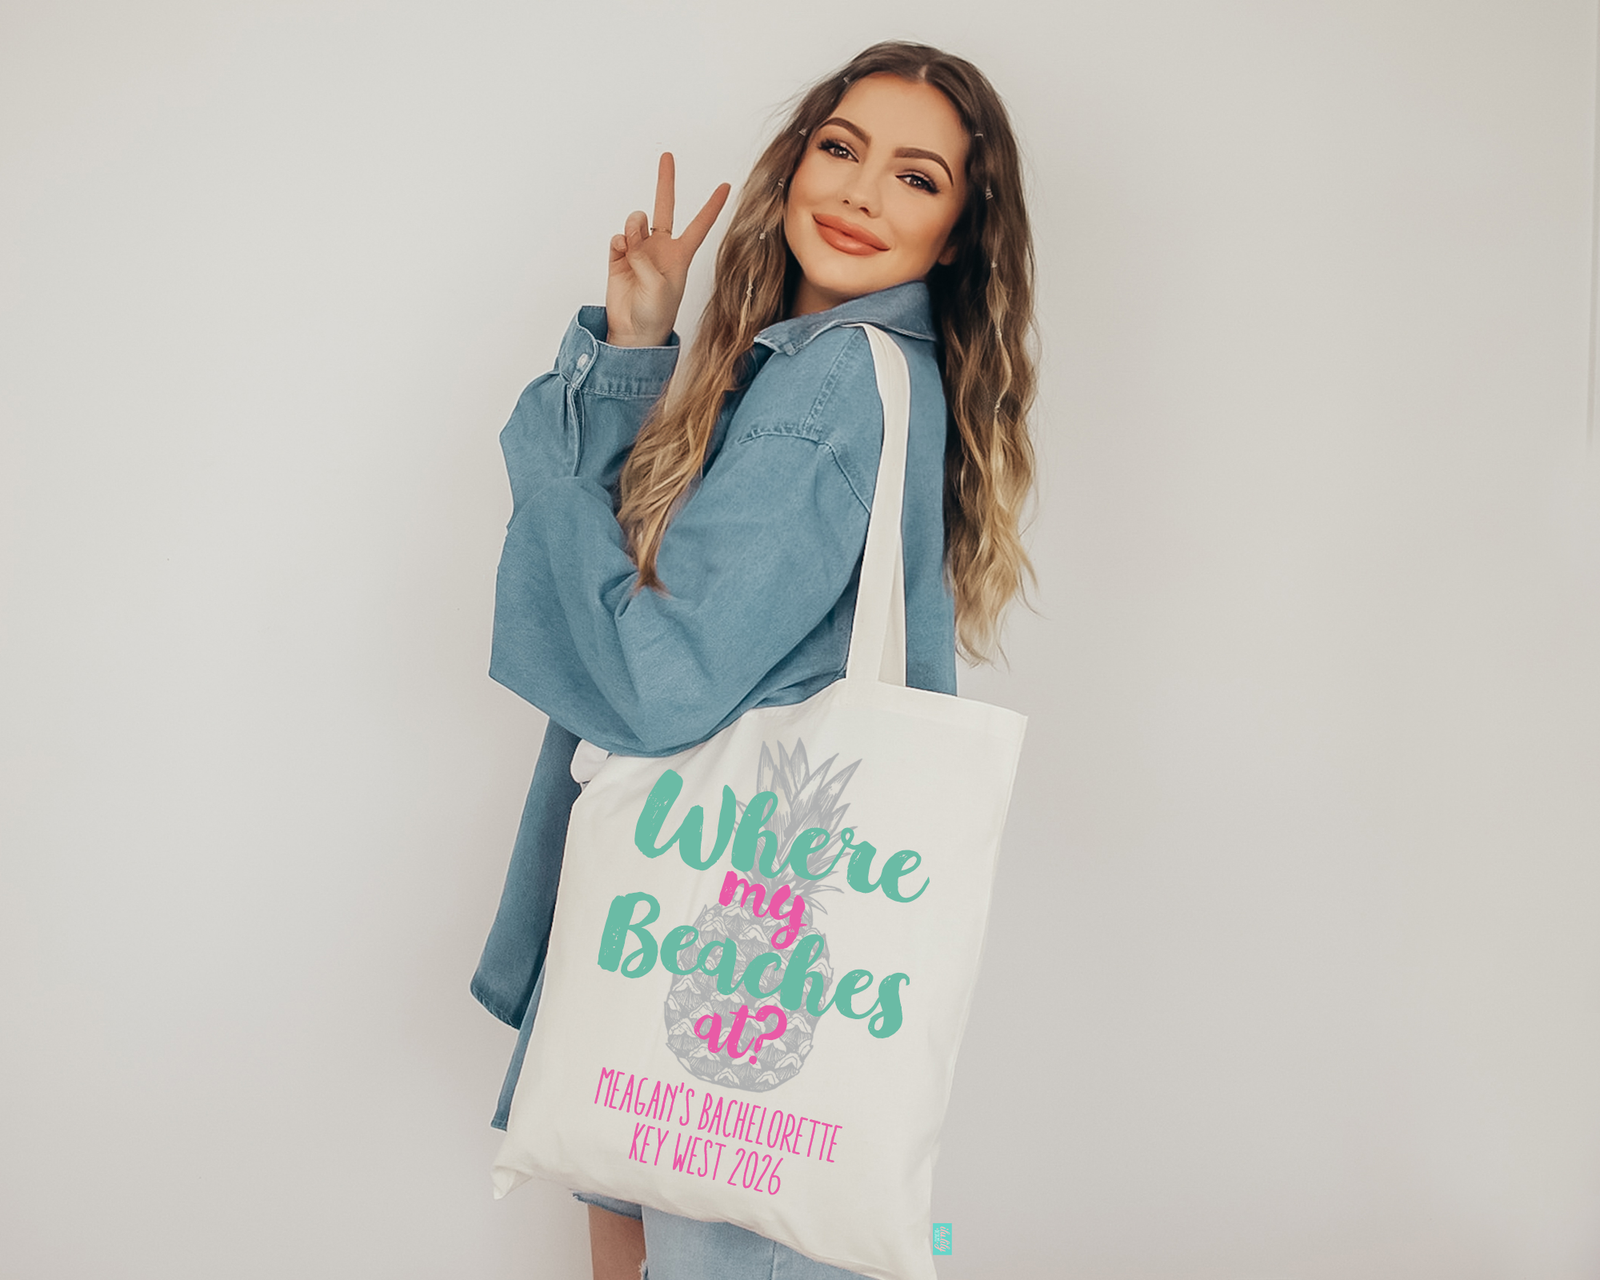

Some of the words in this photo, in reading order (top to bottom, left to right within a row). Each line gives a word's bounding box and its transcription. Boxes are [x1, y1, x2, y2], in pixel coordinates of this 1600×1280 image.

[634, 768, 930, 903] Where
[718, 870, 808, 950] my
[597, 891, 910, 1039] Beaches
[693, 1004, 788, 1066] at?
[593, 1066, 696, 1127] MEAGAN'S
[696, 1092, 844, 1164] BACHELORETTE
[628, 1121, 670, 1167] KEY
[672, 1132, 727, 1181] WEST
[726, 1147, 785, 1196] 2026
